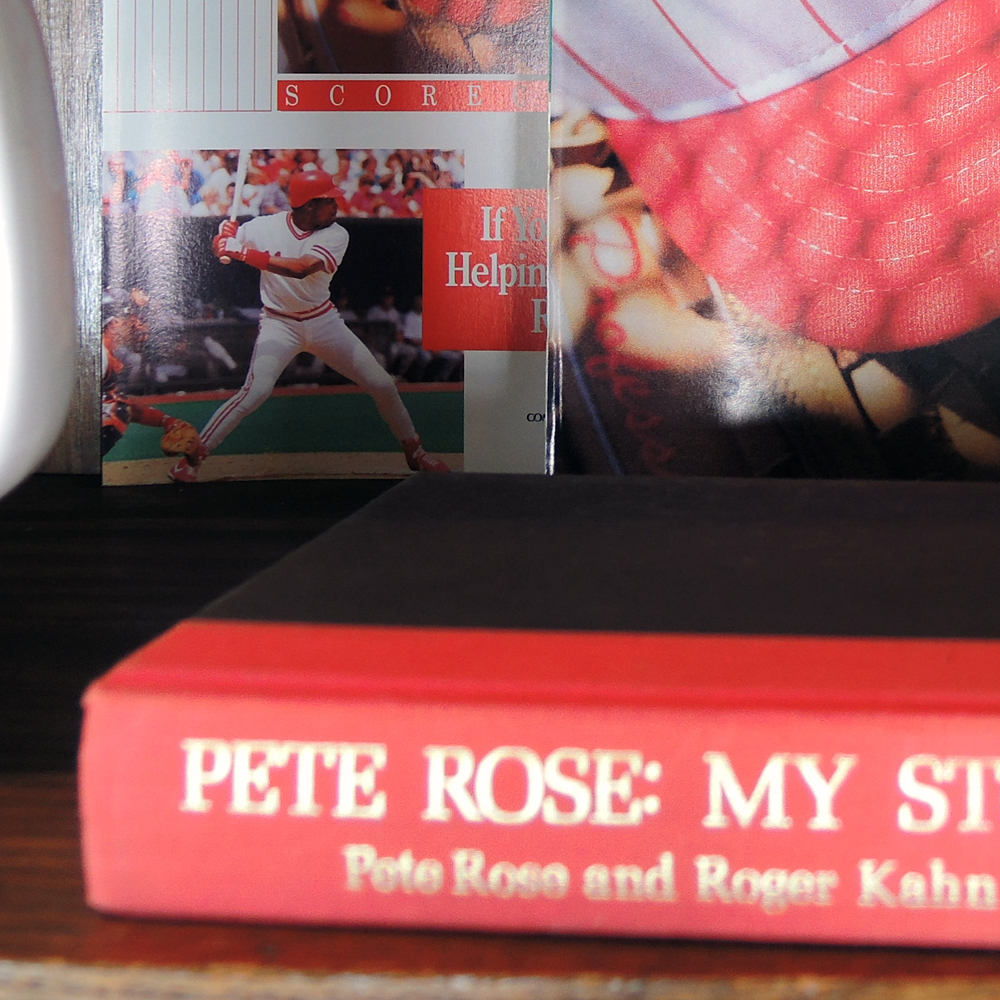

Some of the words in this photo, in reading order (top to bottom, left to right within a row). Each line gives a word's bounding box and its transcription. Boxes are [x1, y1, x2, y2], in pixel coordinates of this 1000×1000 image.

[480, 206, 508, 241] If
[178, 737, 389, 819] PETE
[420, 743, 662, 827] ROSE:
[701, 749, 860, 833] MY
[340, 842, 445, 895] Pete
[451, 847, 571, 900] Rose
[583, 850, 676, 902] and
[693, 853, 841, 915] Roger
[857, 856, 1000, 911] Kahn
